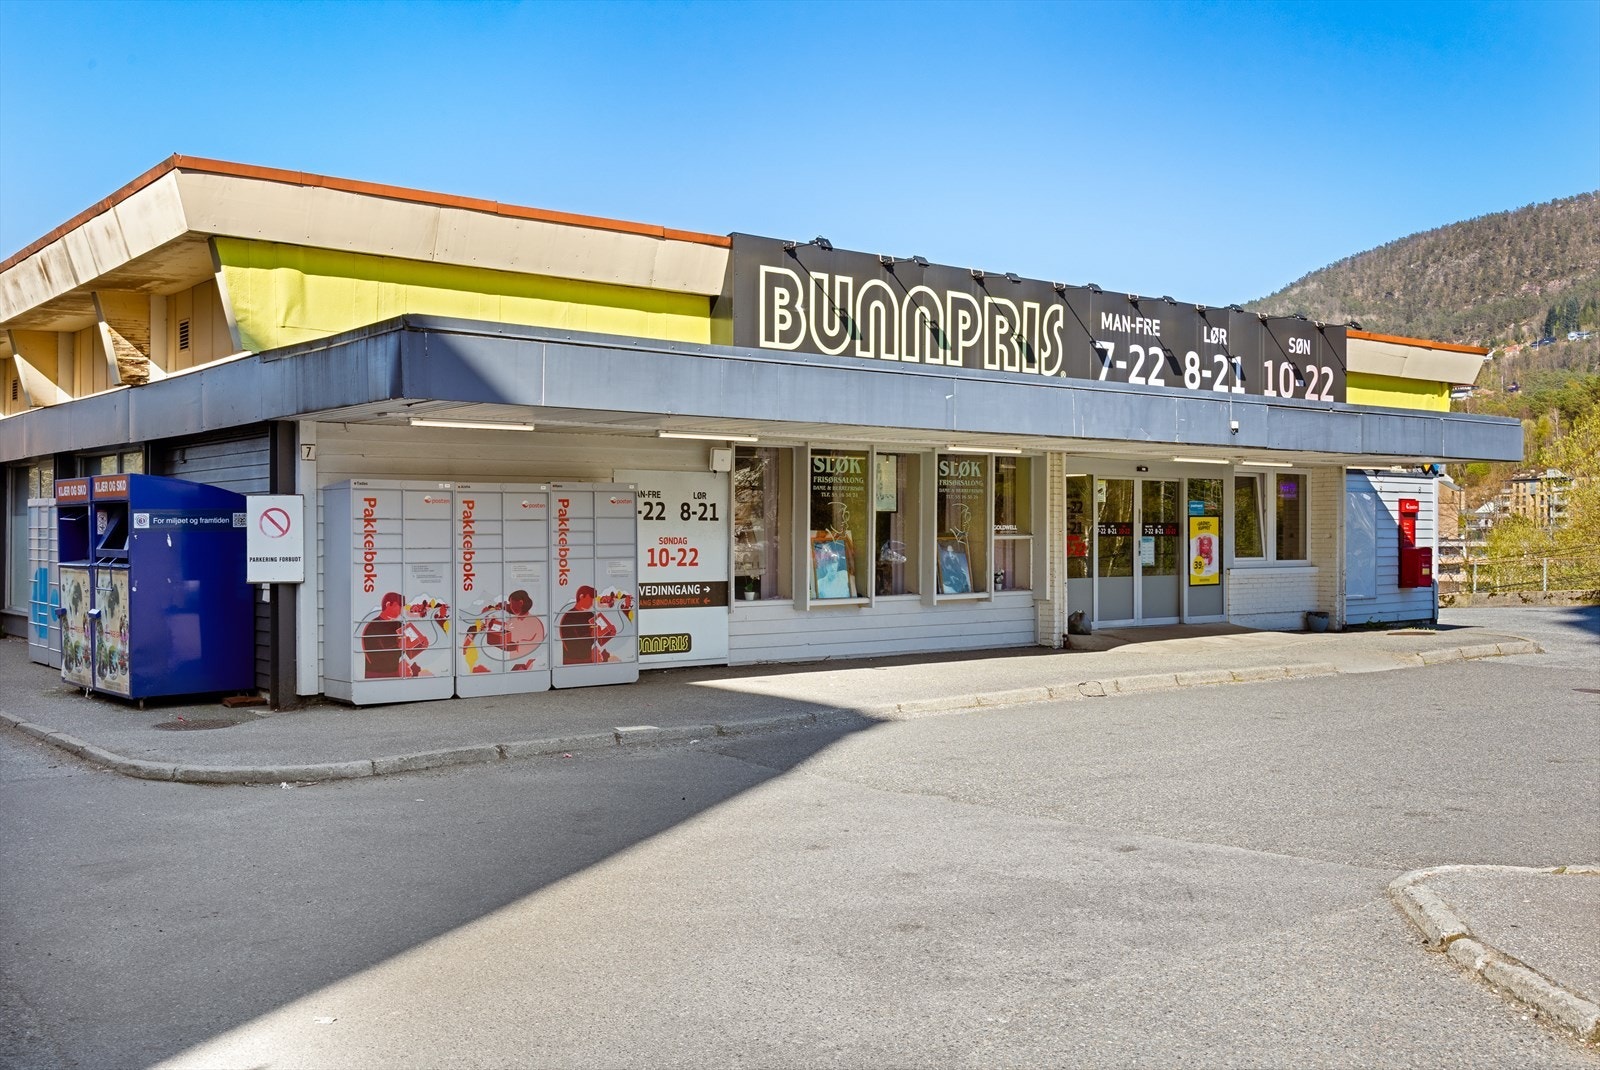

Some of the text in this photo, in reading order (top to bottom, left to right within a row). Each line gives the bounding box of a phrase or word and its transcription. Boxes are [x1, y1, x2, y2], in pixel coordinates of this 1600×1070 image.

[760, 265, 1064, 376] BUNNPRIS
[1101, 312, 1161, 337] MAN-FRE
[1203, 326, 1228, 345] LØR
[1288, 337, 1311, 355] SØN
[1095, 340, 1165, 386] 7-22
[1184, 351, 1246, 394] 8-21
[1264, 360, 1334, 402] 10-22
[306, 446, 312, 458] 7
[813, 456, 861, 475] SLØK
[940, 460, 982, 478] SLØK
[59, 486, 70, 497] KLÆR
[71, 485, 77, 496] OG
[95, 479, 127, 493] KLÆR OG SKO
[693, 491, 707, 500] LØR
[165, 516, 188, 525] miljøet
[199, 516, 230, 524] framtiden
[680, 502, 719, 521] 8-21
[364, 498, 377, 592] Pakkeboks
[463, 500, 475, 591] Pakkeboks
[558, 499, 570, 586] Pakkeboks
[658, 536, 688, 545] SØNDAG
[647, 547, 699, 568] 10-22
